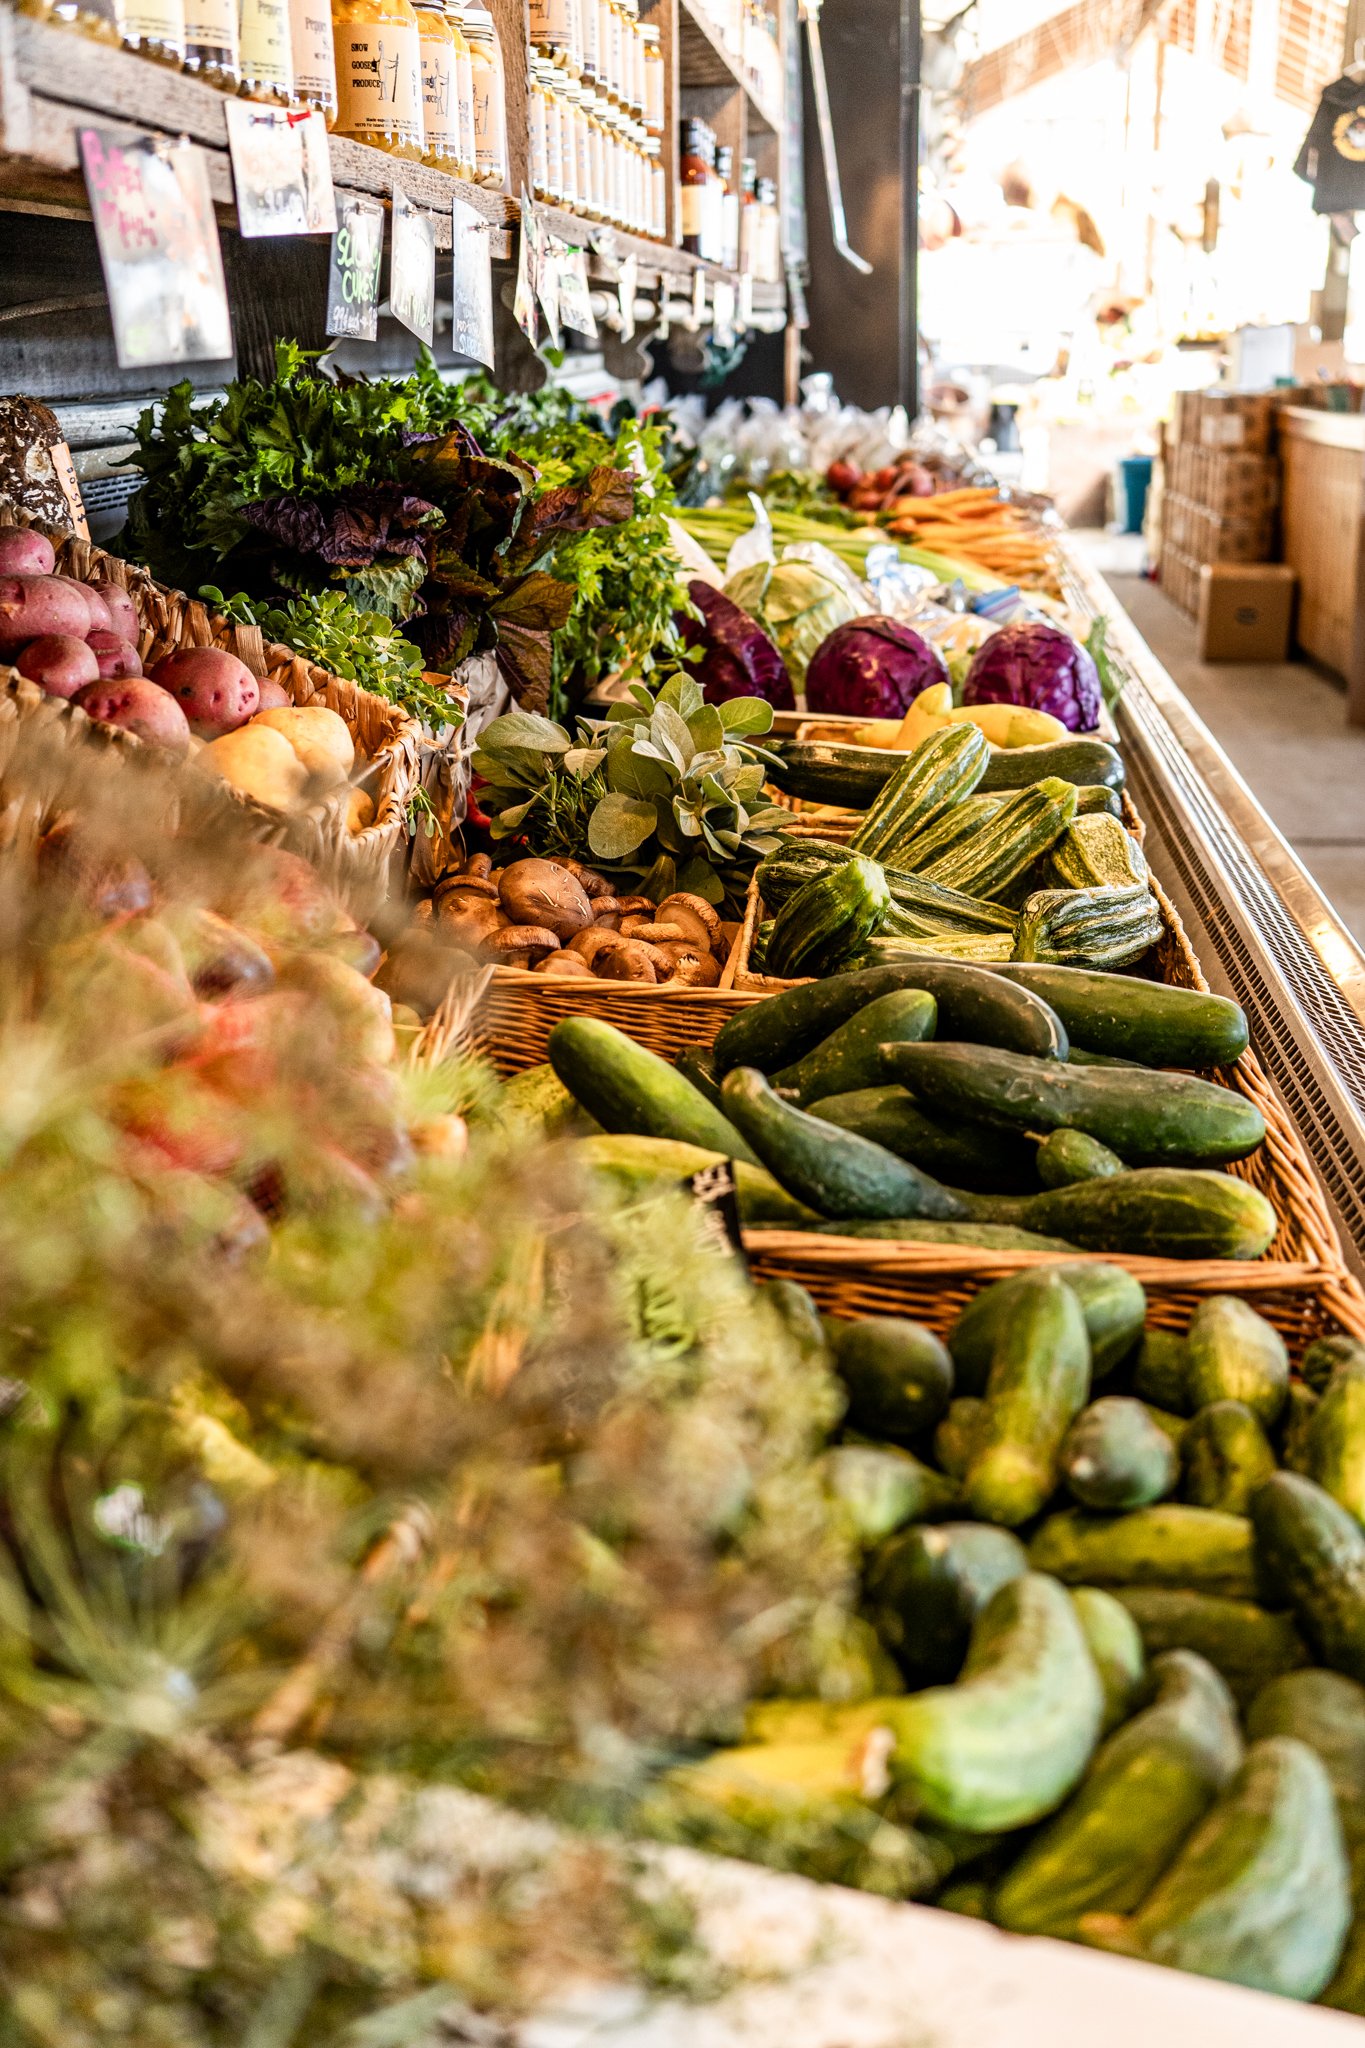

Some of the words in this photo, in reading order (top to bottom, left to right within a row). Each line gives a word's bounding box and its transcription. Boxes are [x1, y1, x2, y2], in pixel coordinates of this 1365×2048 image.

[351, 43, 368, 52] SNOW
[352, 61, 371, 70] GOOSE
[352, 79, 380, 88] PRODUCE
